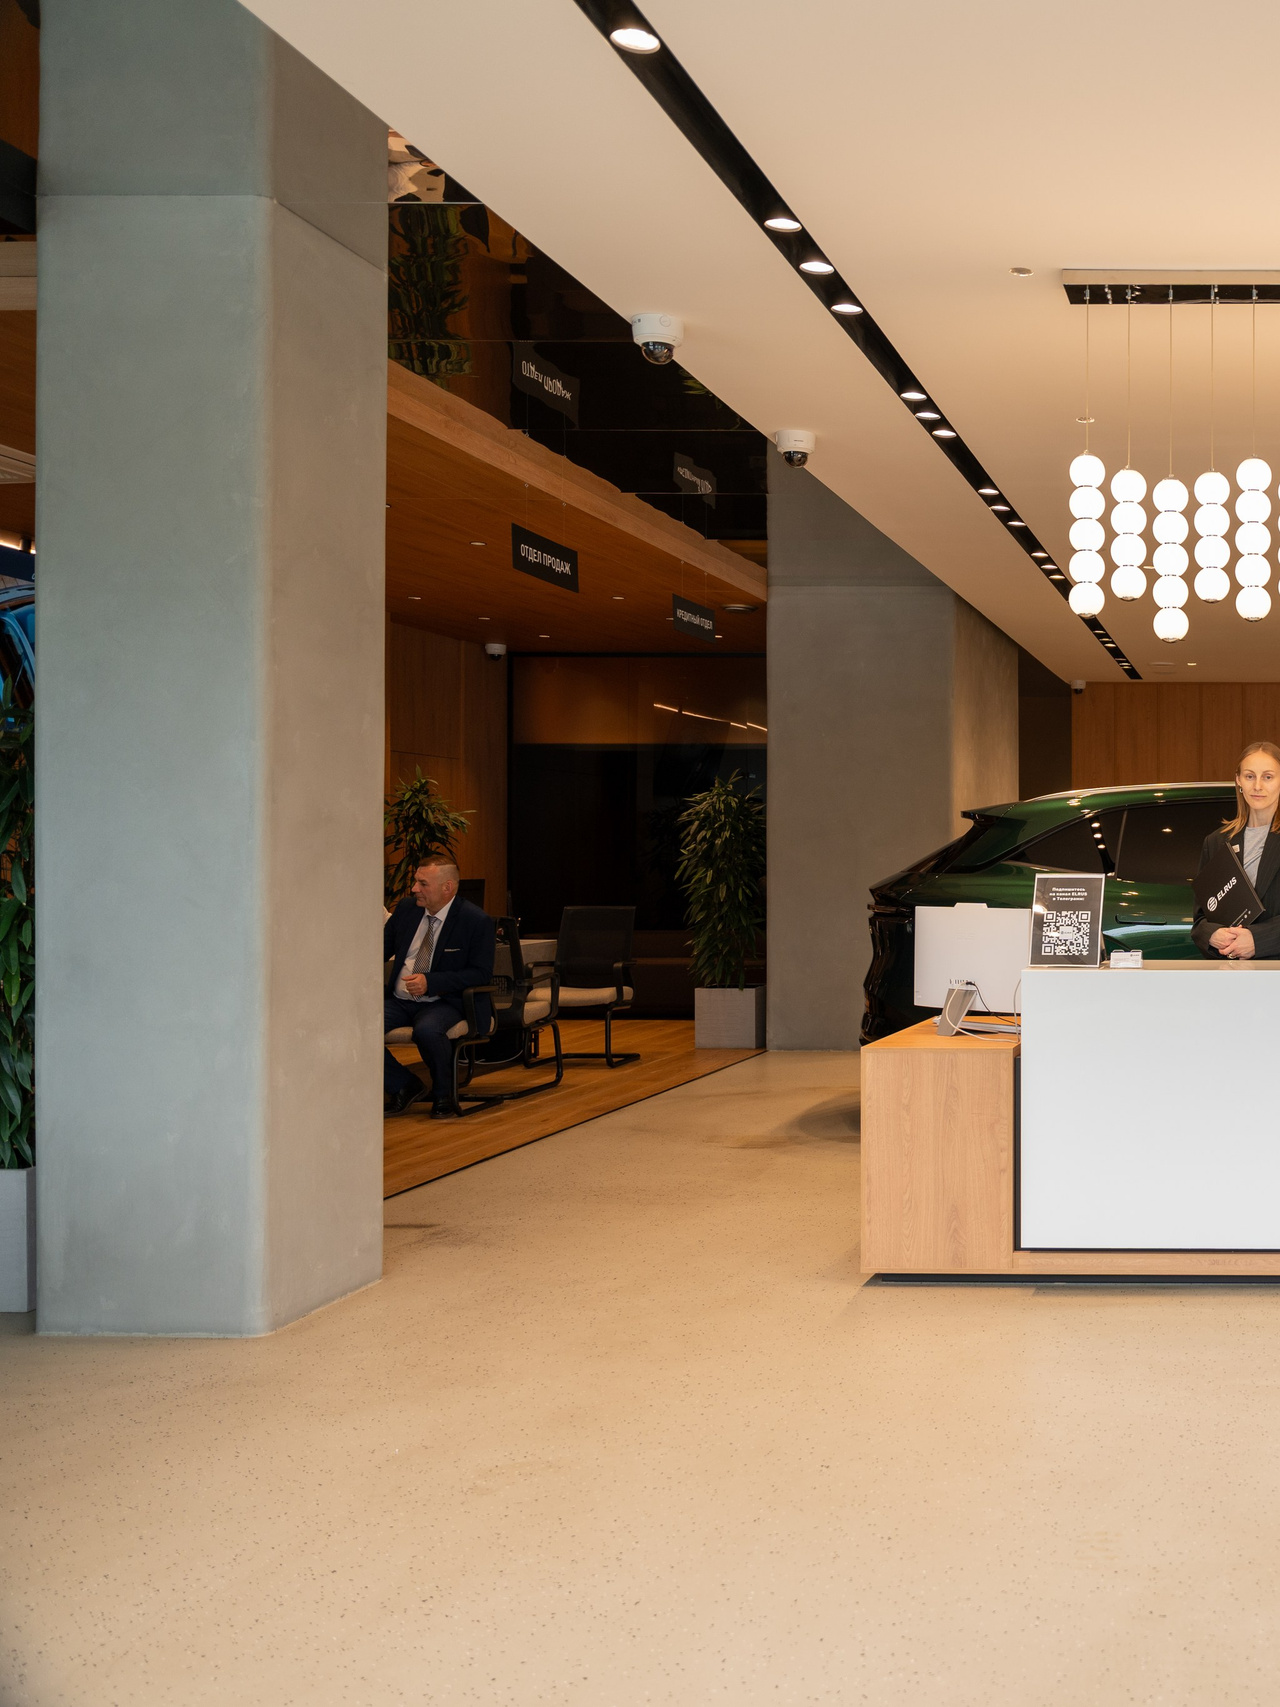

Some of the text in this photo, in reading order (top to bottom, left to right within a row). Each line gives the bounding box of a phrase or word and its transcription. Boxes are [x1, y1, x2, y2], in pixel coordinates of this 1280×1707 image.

[521, 543, 571, 576] ОТДЕЛ ПРОДАЖ
[676, 608, 713, 630] КРЕДИТНЫЙ ОТДЕЛ
[1216, 876, 1237, 901] ELRUS
